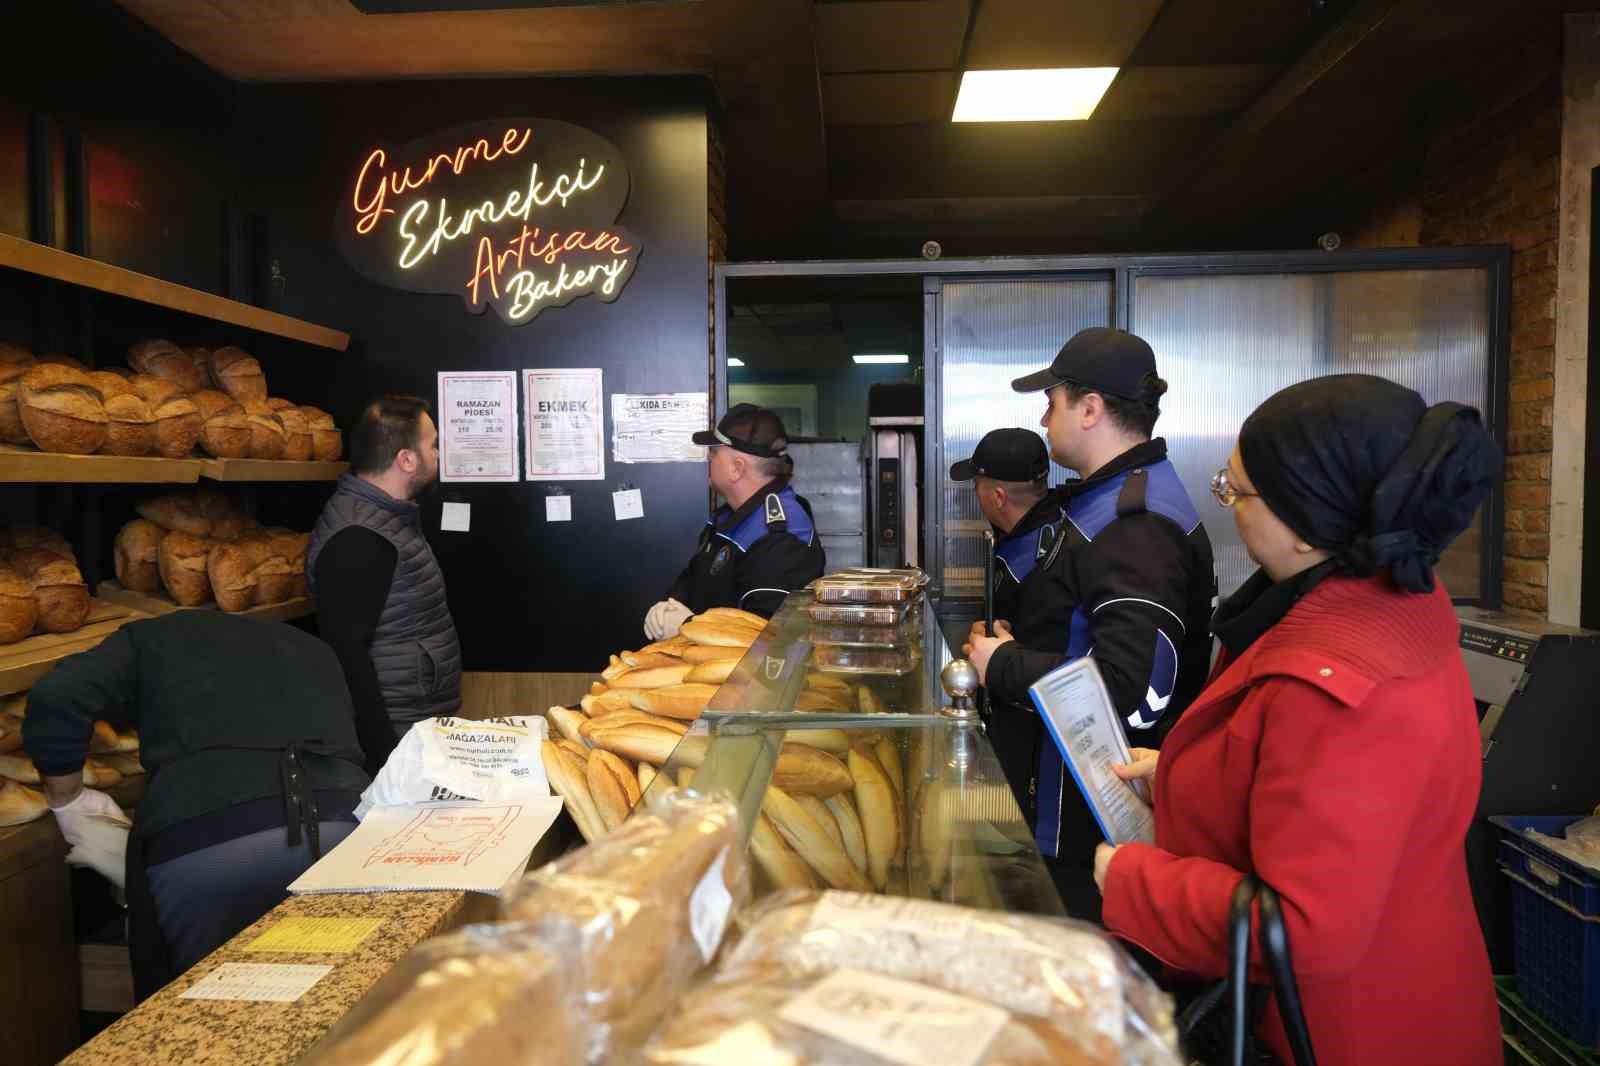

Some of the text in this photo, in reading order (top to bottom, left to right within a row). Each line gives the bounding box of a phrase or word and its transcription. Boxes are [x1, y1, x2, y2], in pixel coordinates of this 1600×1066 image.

[353, 127, 531, 234] Gurme
[399, 158, 604, 268] Ekmekçi
[466, 225, 630, 304] Artisan
[505, 259, 627, 318] Bakery
[456, 400, 501, 408] RAMAZAN
[538, 401, 588, 412] EKMEK
